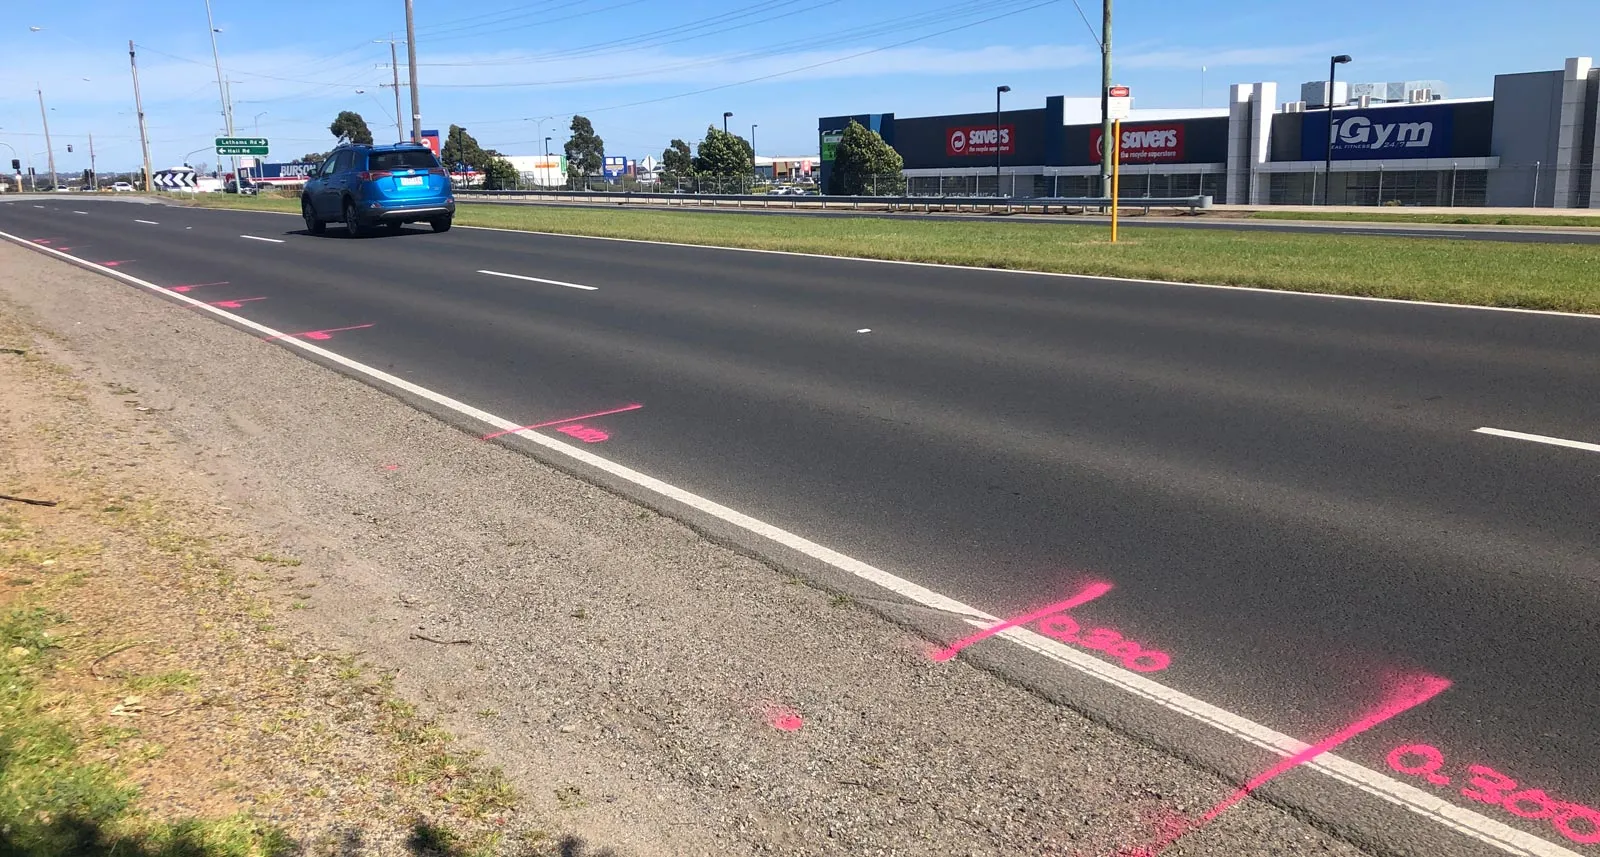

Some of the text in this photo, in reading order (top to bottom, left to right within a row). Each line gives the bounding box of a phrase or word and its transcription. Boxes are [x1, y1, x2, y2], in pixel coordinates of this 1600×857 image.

[969, 129, 1009, 145] savers
[1121, 129, 1177, 149] savers
[1331, 116, 1433, 149] iGym
[1120, 150, 1129, 158] the
[1386, 743, 1600, 845] 0.300
